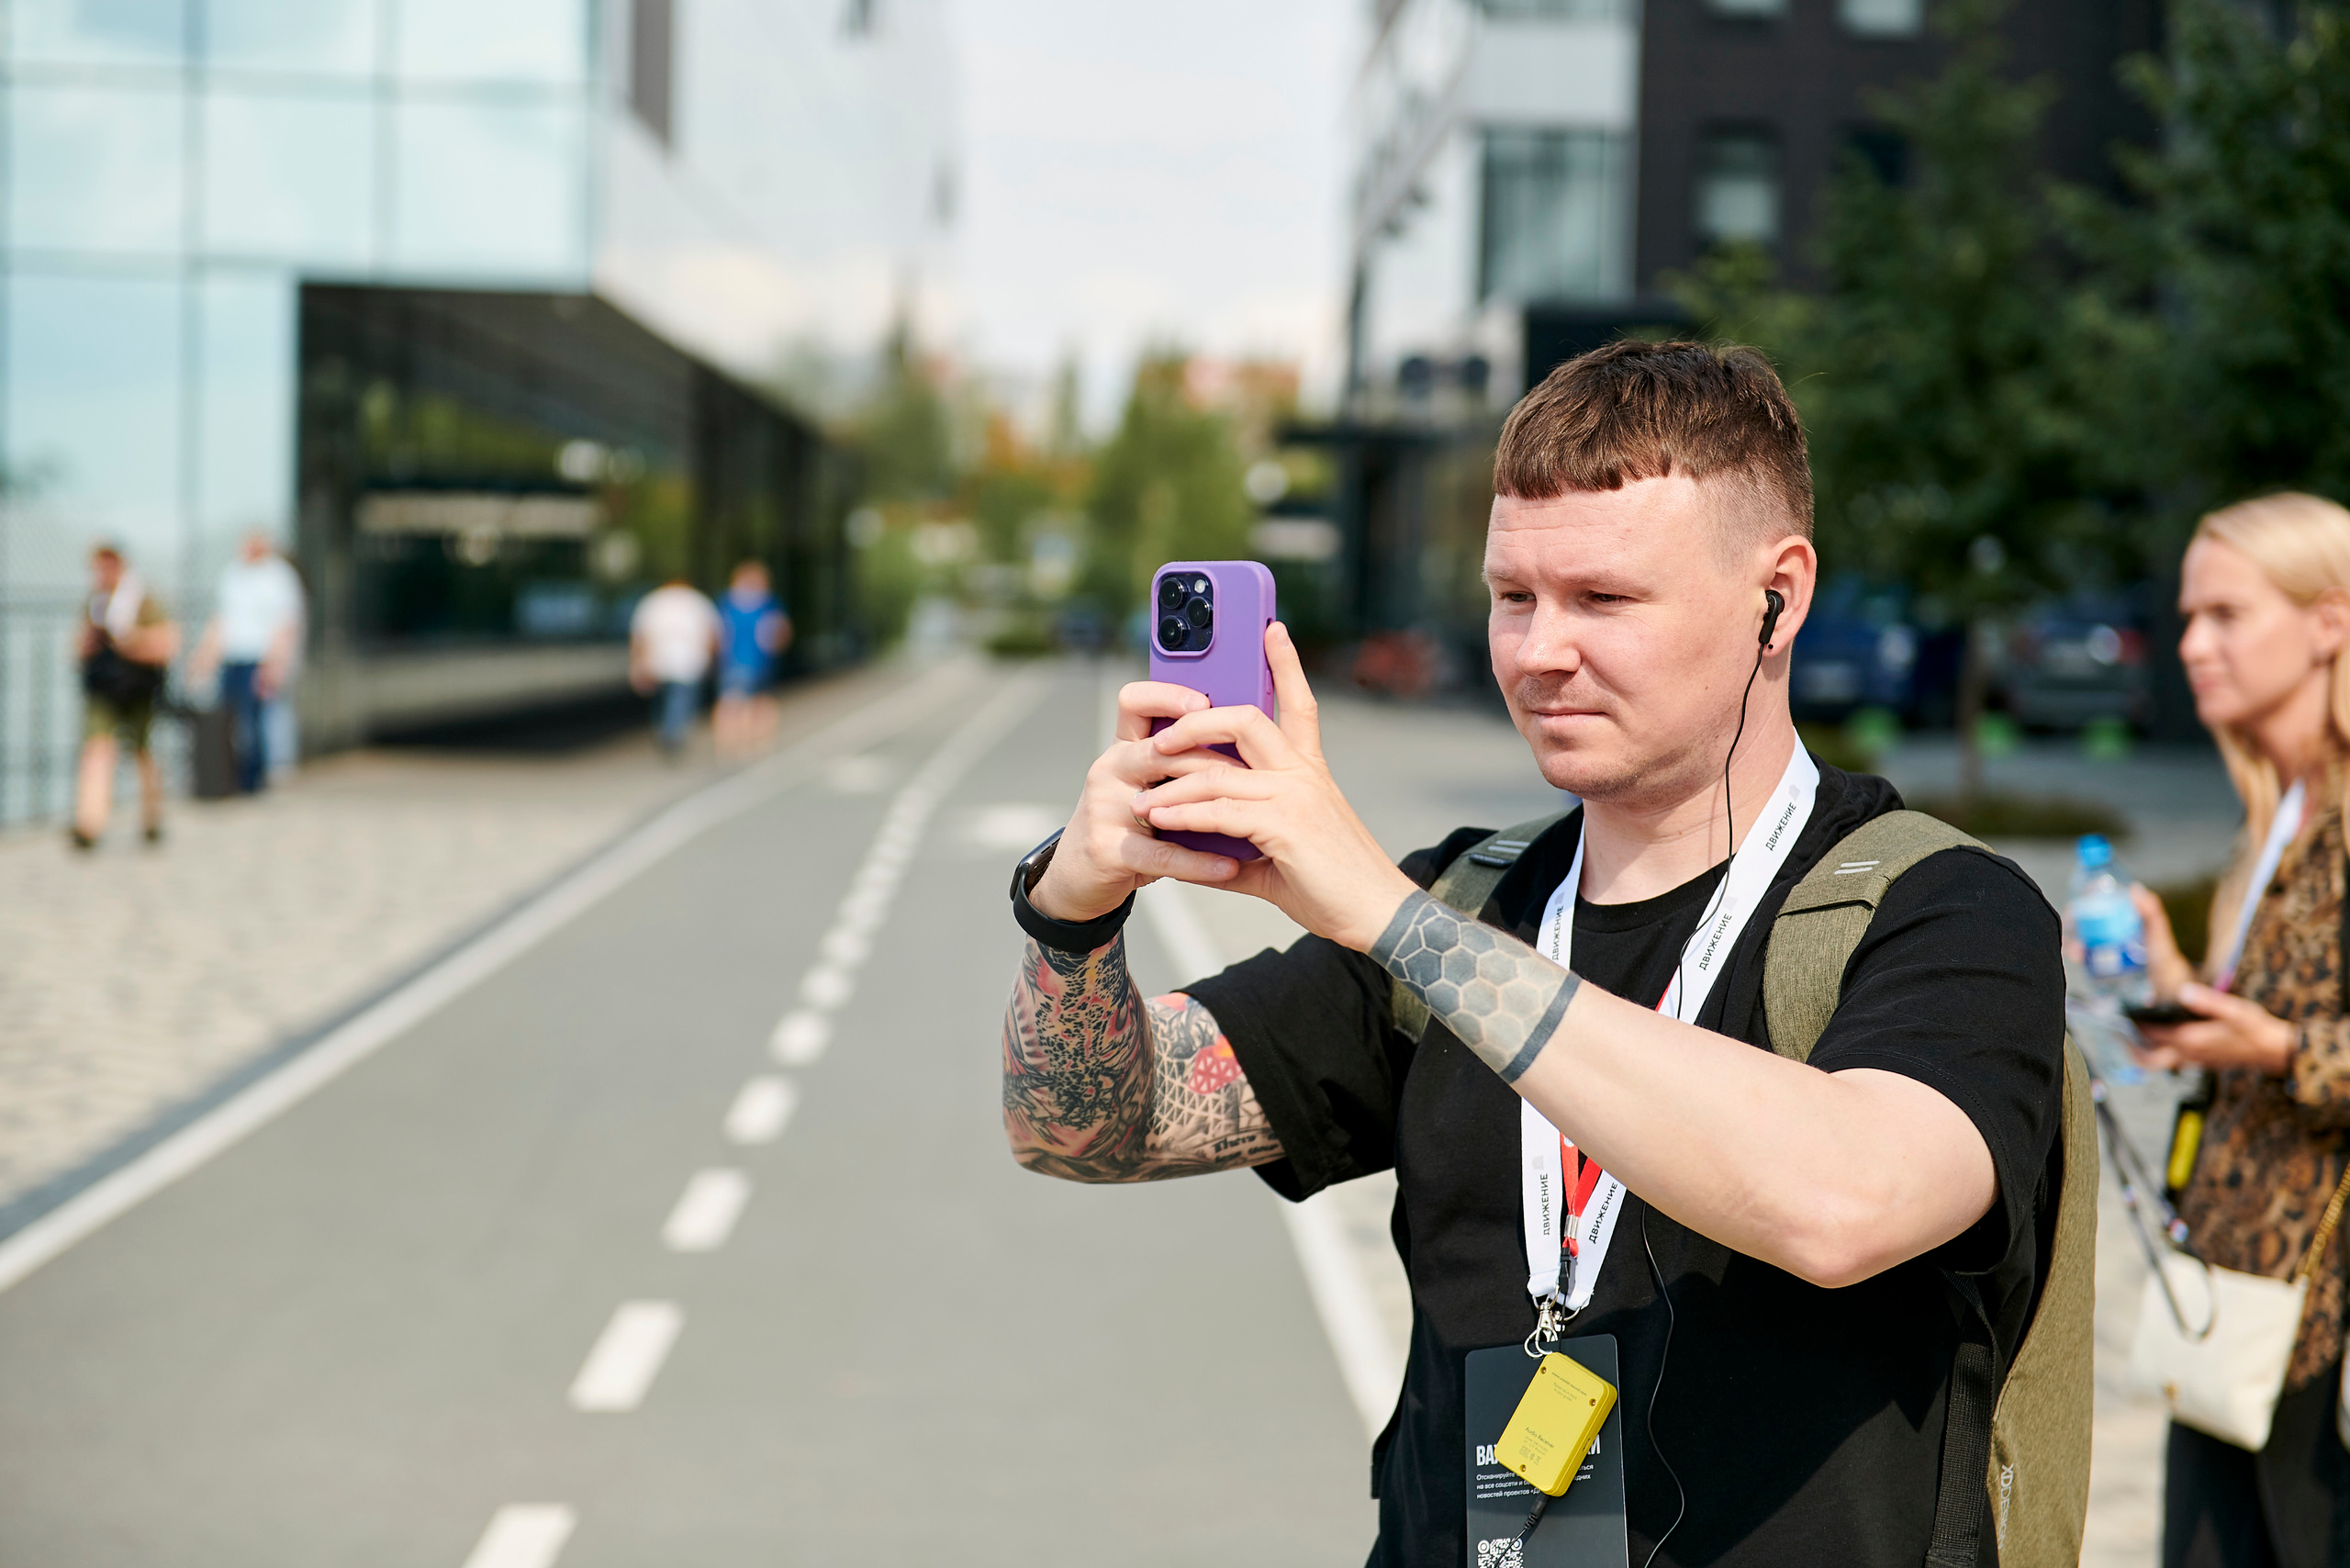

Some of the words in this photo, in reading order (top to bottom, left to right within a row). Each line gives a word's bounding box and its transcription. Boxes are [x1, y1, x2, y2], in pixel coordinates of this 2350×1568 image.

[1765, 801, 1796, 851] ДВИЖЕНИЕ
[1551, 905, 1564, 960] ДВИЖЕНИЕ
[1699, 913, 1732, 971] ДВИЖЕНИЕ
[1540, 1173, 1550, 1236] ДВИЖЕНИЕ
[1588, 1182, 1617, 1244] ДВИЖЕНИЕ
[1525, 1427, 1538, 1438] Audio
[1538, 1434, 1555, 1448] Receiver
[1476, 1472, 1515, 1481] Отсканируйте
[1476, 1490, 1503, 1499] новостей
[1504, 1489, 1530, 1497] проектов
